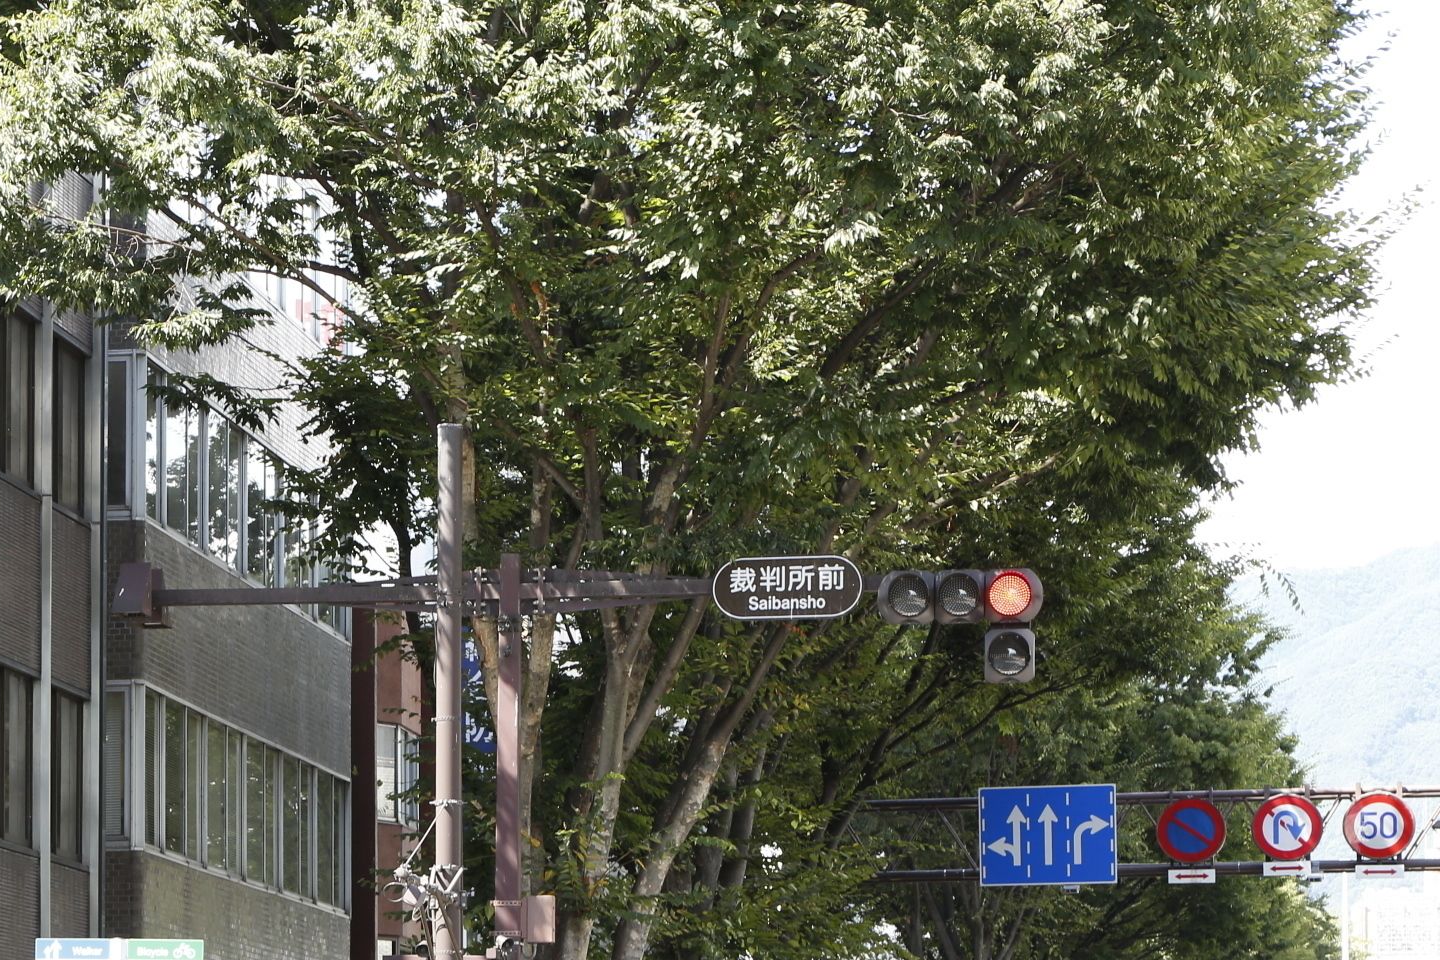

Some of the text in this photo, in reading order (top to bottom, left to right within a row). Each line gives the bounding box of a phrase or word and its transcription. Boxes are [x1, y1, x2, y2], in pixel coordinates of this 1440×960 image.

[729, 564, 845, 593] 裁判所前
[748, 595, 826, 610] Saibansho
[1360, 811, 1398, 840] 50
